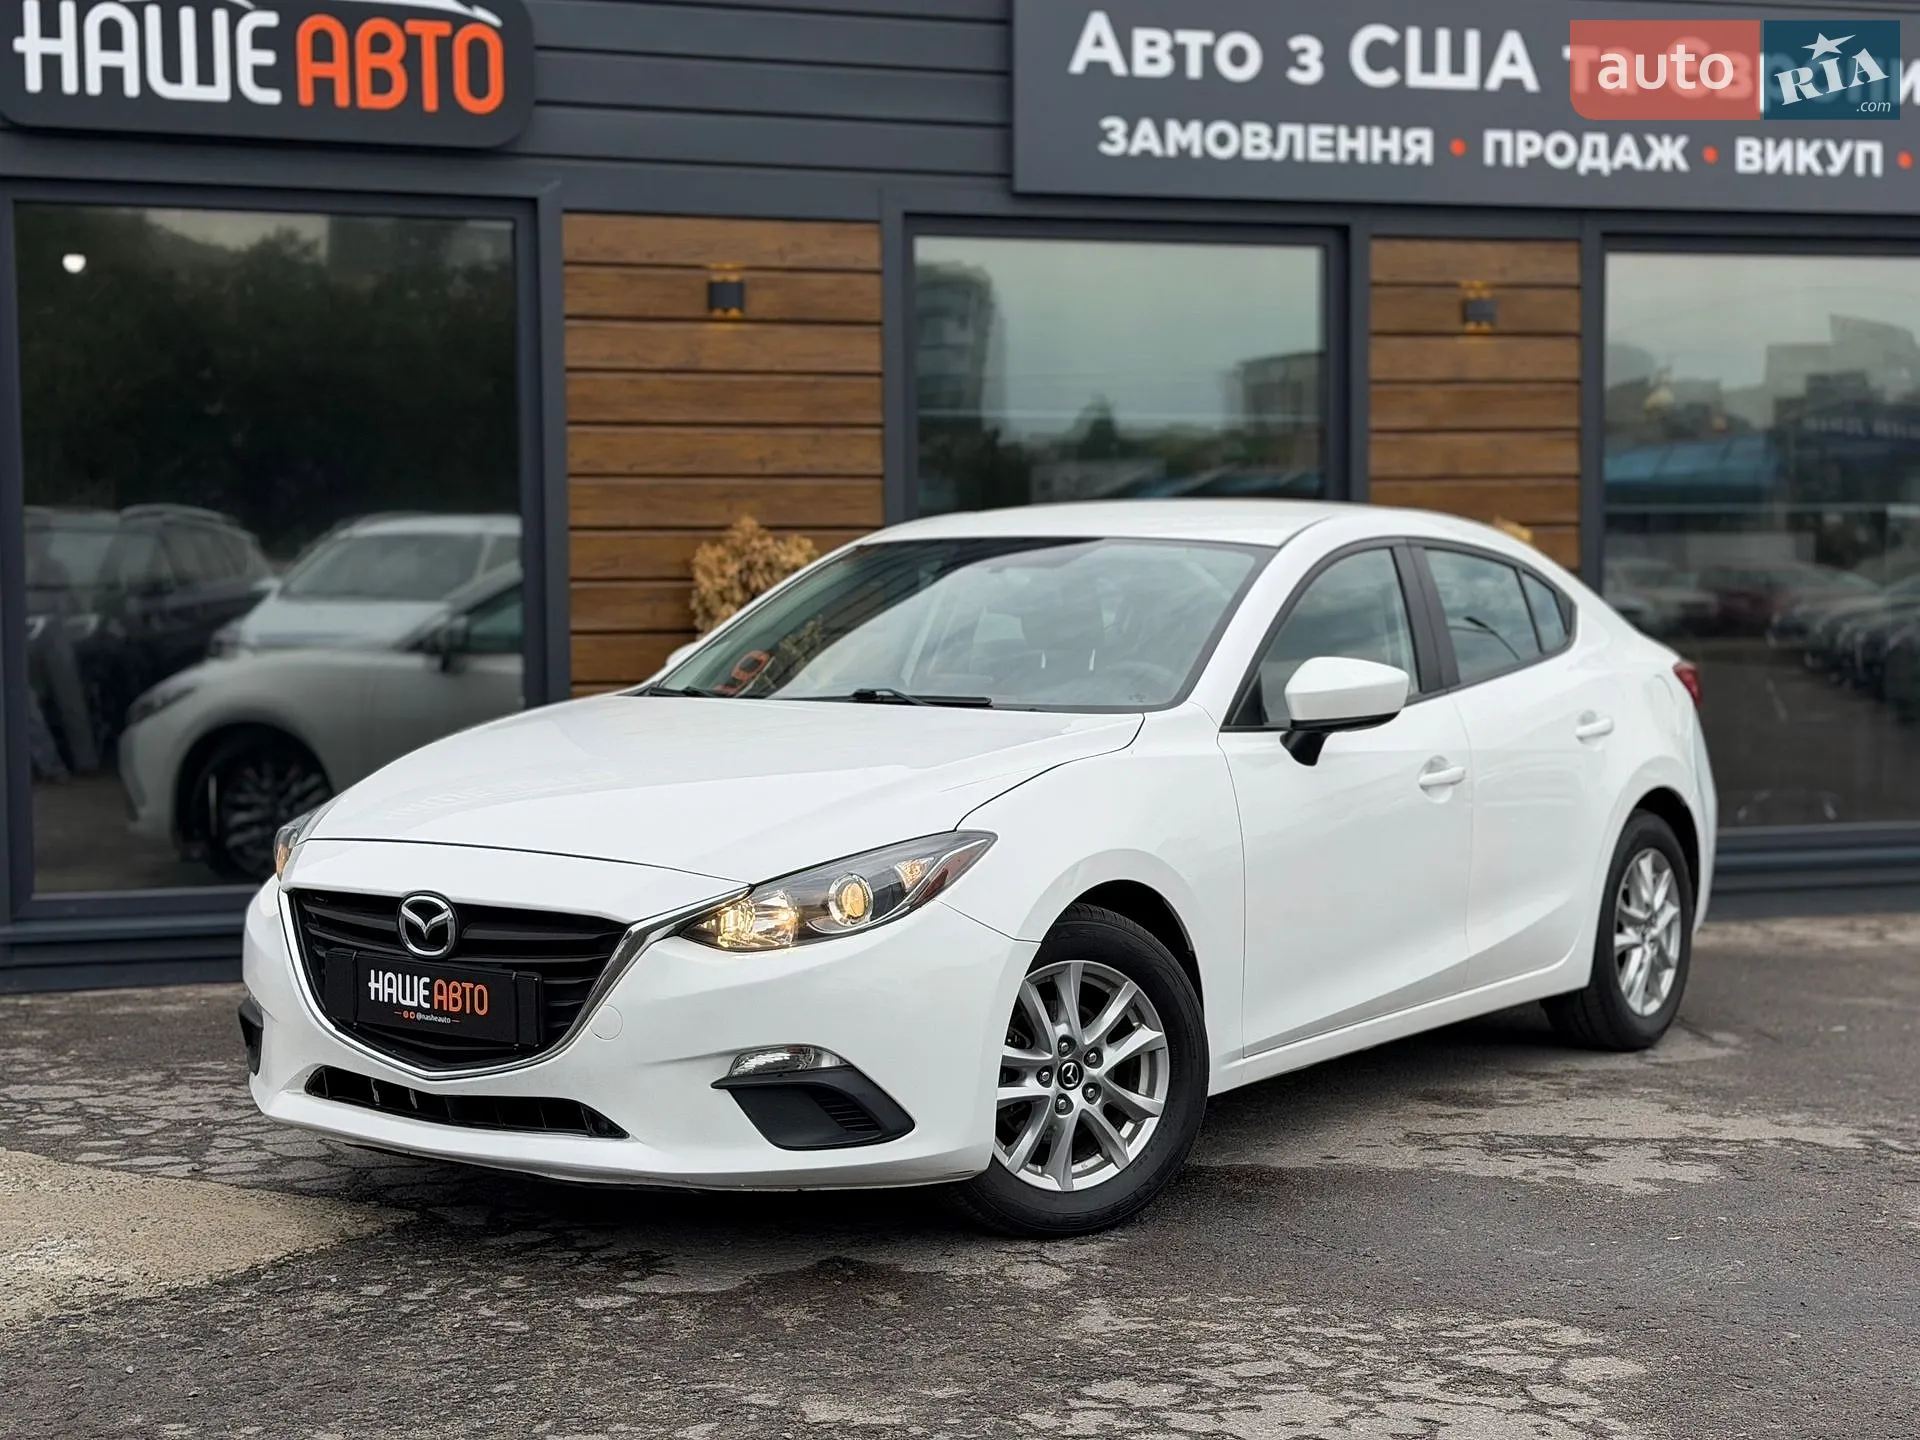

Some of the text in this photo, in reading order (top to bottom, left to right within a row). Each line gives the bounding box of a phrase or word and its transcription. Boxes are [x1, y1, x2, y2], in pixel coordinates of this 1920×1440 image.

[13, 0, 505, 115] НАШЕ АВТО
[1068, 10, 1264, 83] Авто
[1348, 23, 1541, 93] США
[1098, 115, 1884, 178] ЗАМОВЛЕННЯ ПРОДАЖ ВИКУП
[368, 969, 489, 1016] НАШЕ АВТО
